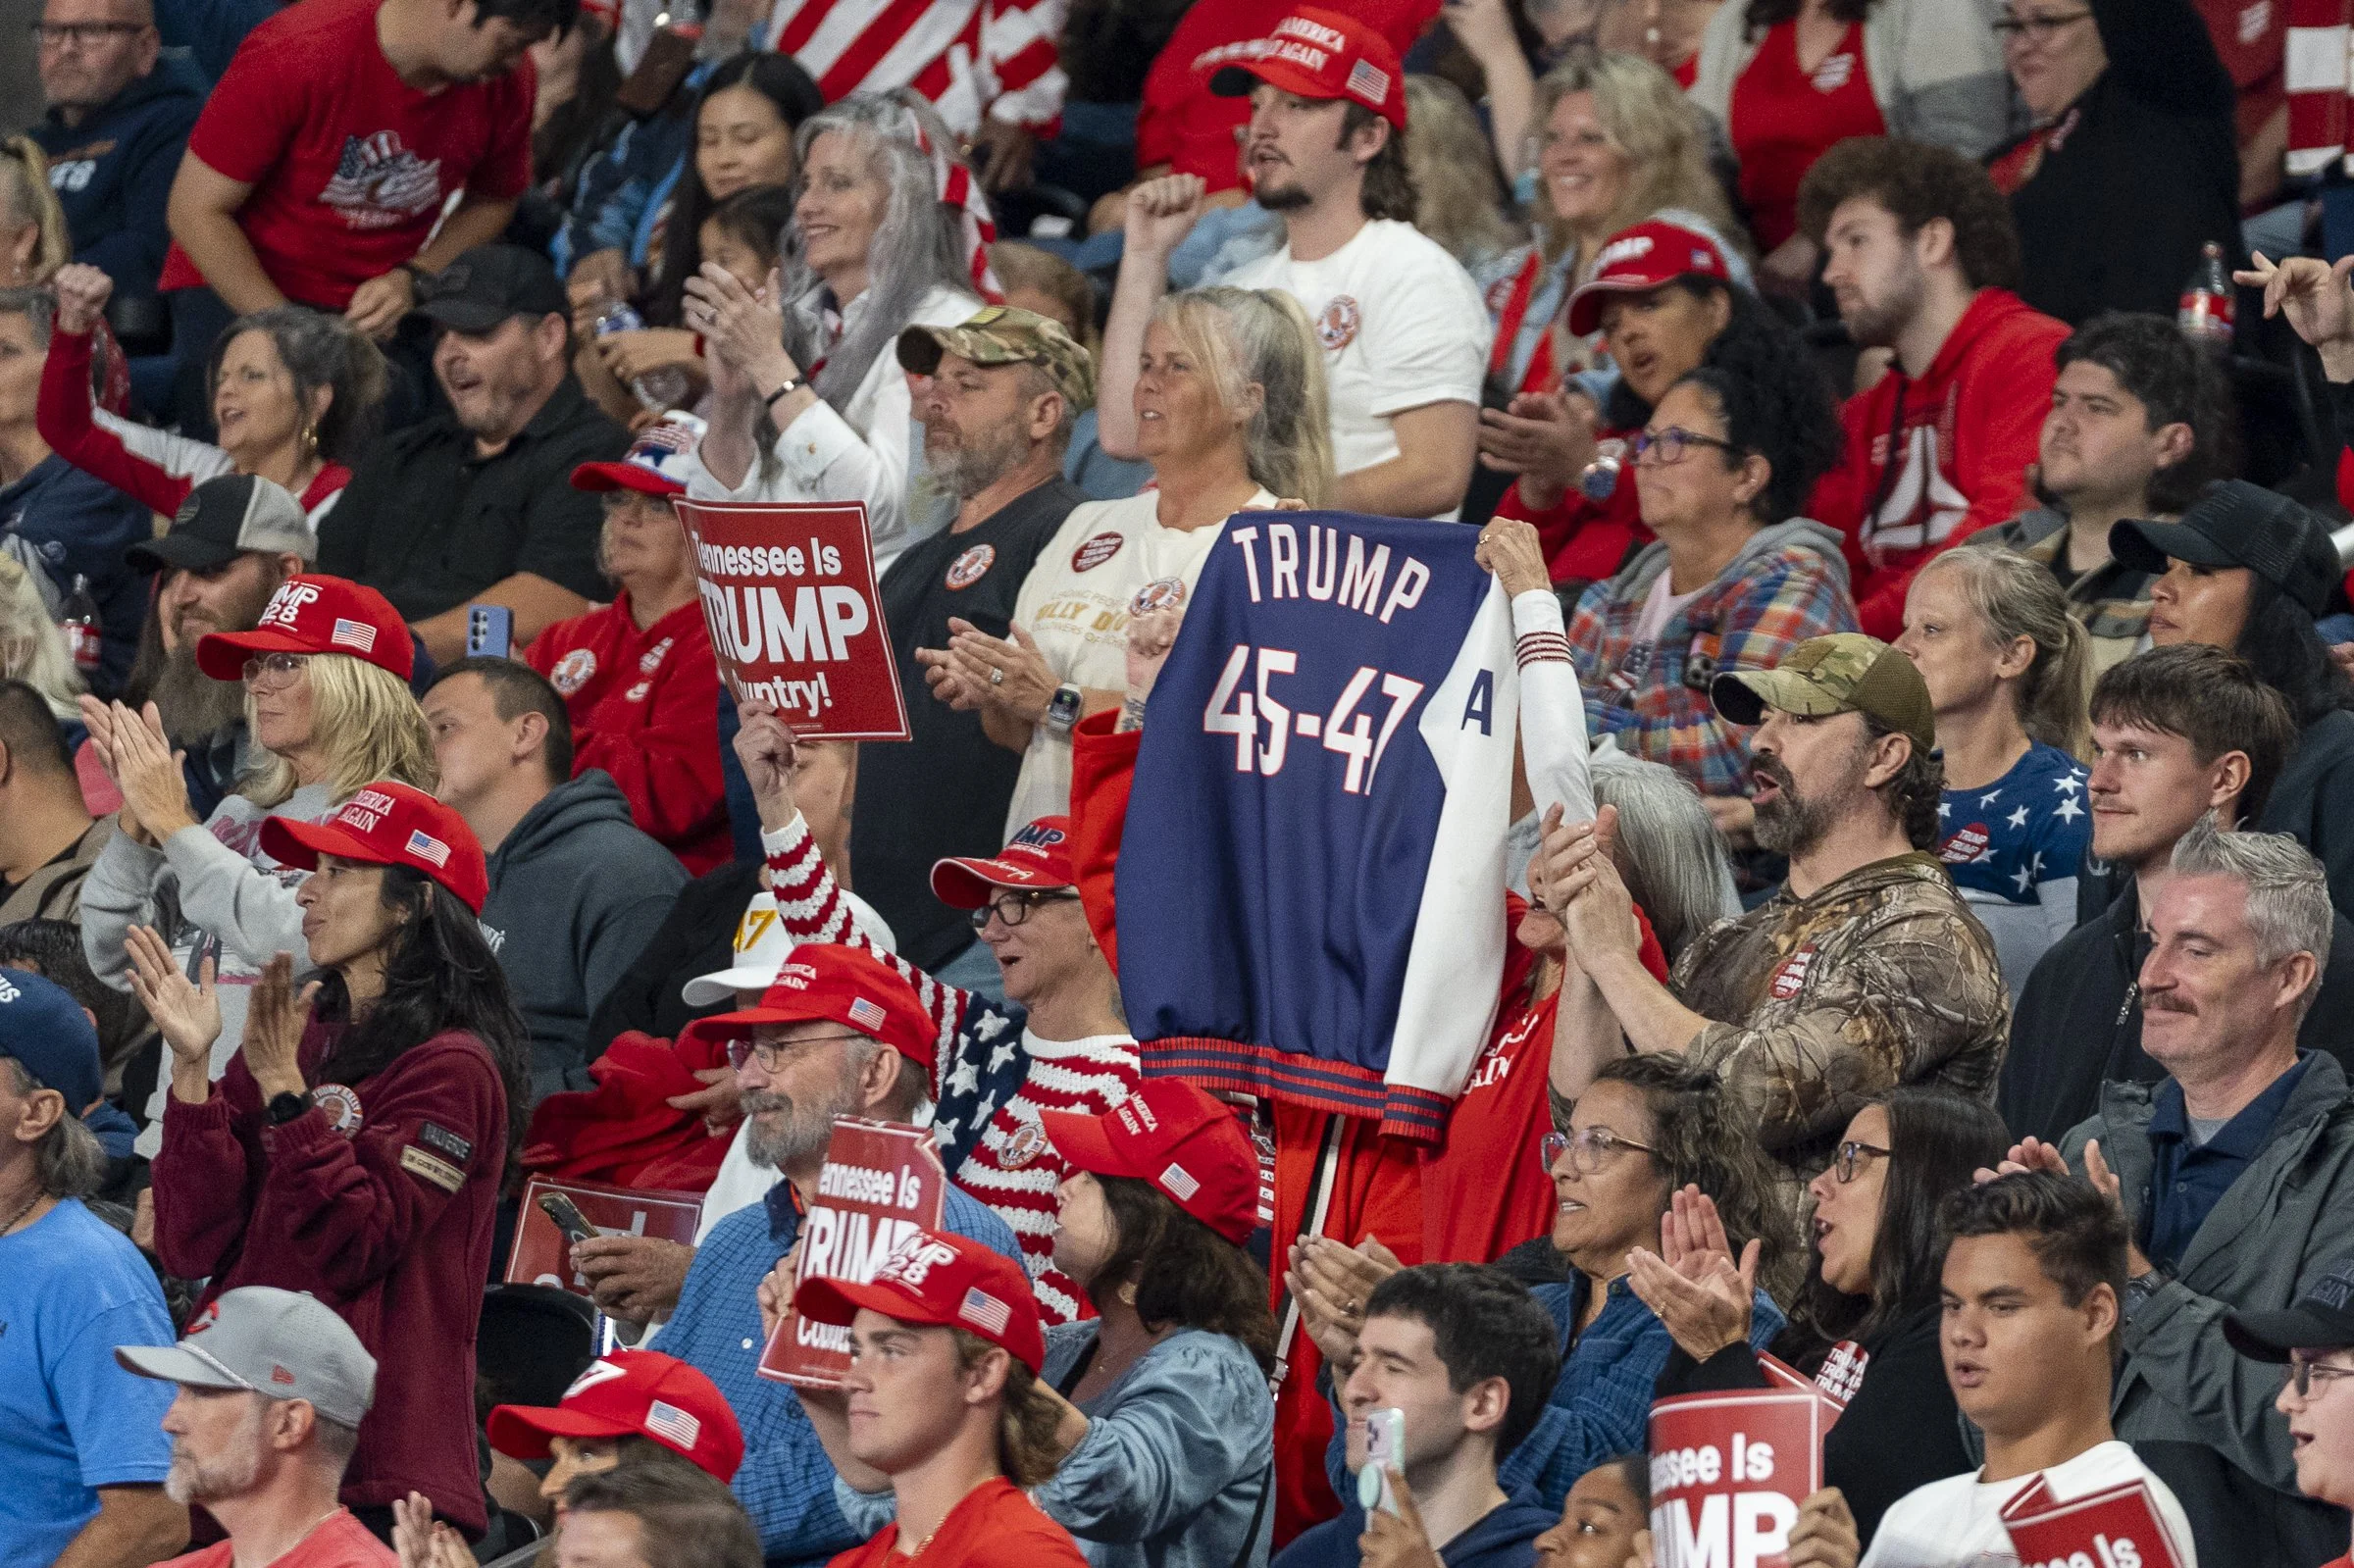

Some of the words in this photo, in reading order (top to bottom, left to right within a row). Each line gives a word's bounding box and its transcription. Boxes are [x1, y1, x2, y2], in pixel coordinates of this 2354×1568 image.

[691, 531, 805, 577] Tennessee
[810, 537, 842, 576] Is
[1231, 524, 1430, 625] TRUMP
[697, 577, 869, 663] TRUMP
[1203, 642, 1425, 797] 45-47
[1459, 667, 1495, 737] A
[818, 1163, 895, 1206] ennessee
[896, 1164, 921, 1210] Is
[1732, 1432, 1774, 1482] Is
